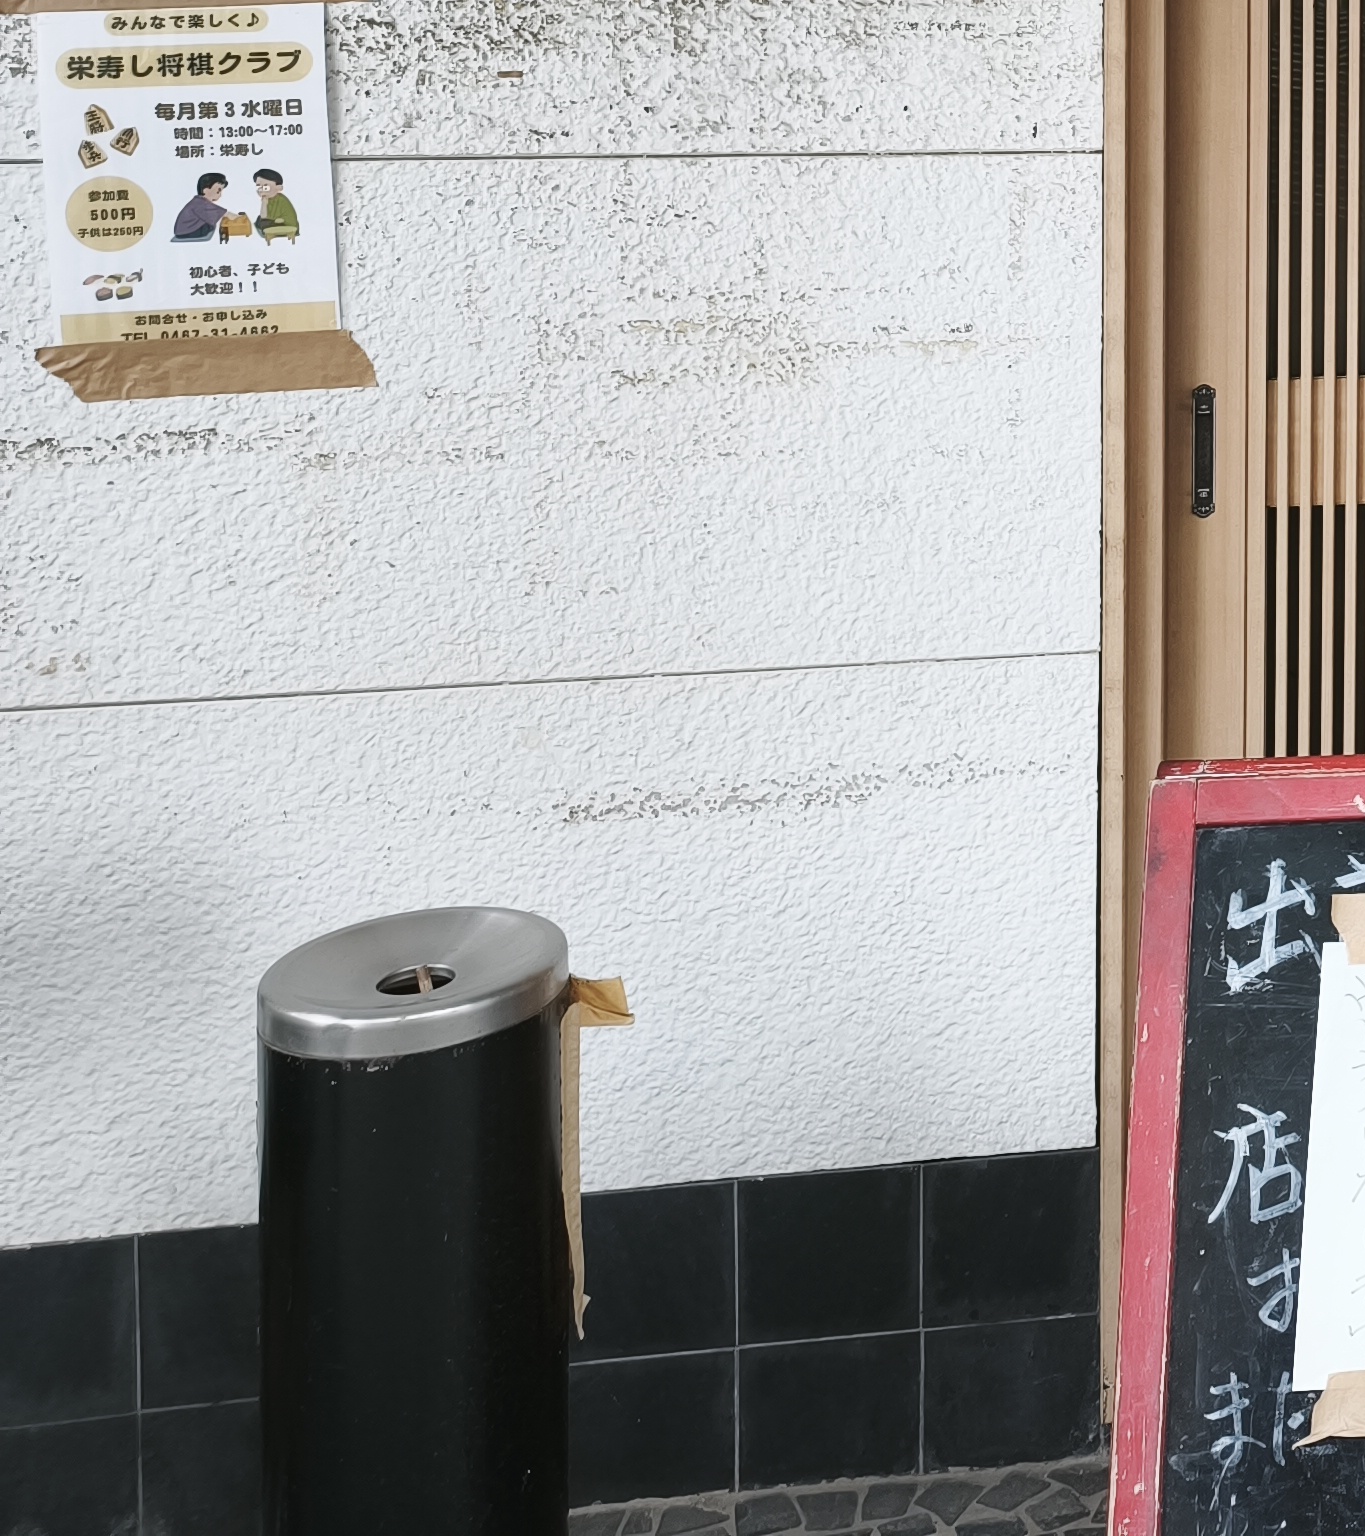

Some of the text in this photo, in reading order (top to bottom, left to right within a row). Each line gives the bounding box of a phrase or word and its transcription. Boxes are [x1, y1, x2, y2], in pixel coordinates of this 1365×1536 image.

[67, 49, 302, 80] 栄寿し将棋クラブ
[90, 207, 136, 221] 500円
[189, 263, 290, 279] 初心者、子ども
[190, 281, 258, 296] 大歓迎！！
[134, 309, 268, 326] お問合せ・お申し込み
